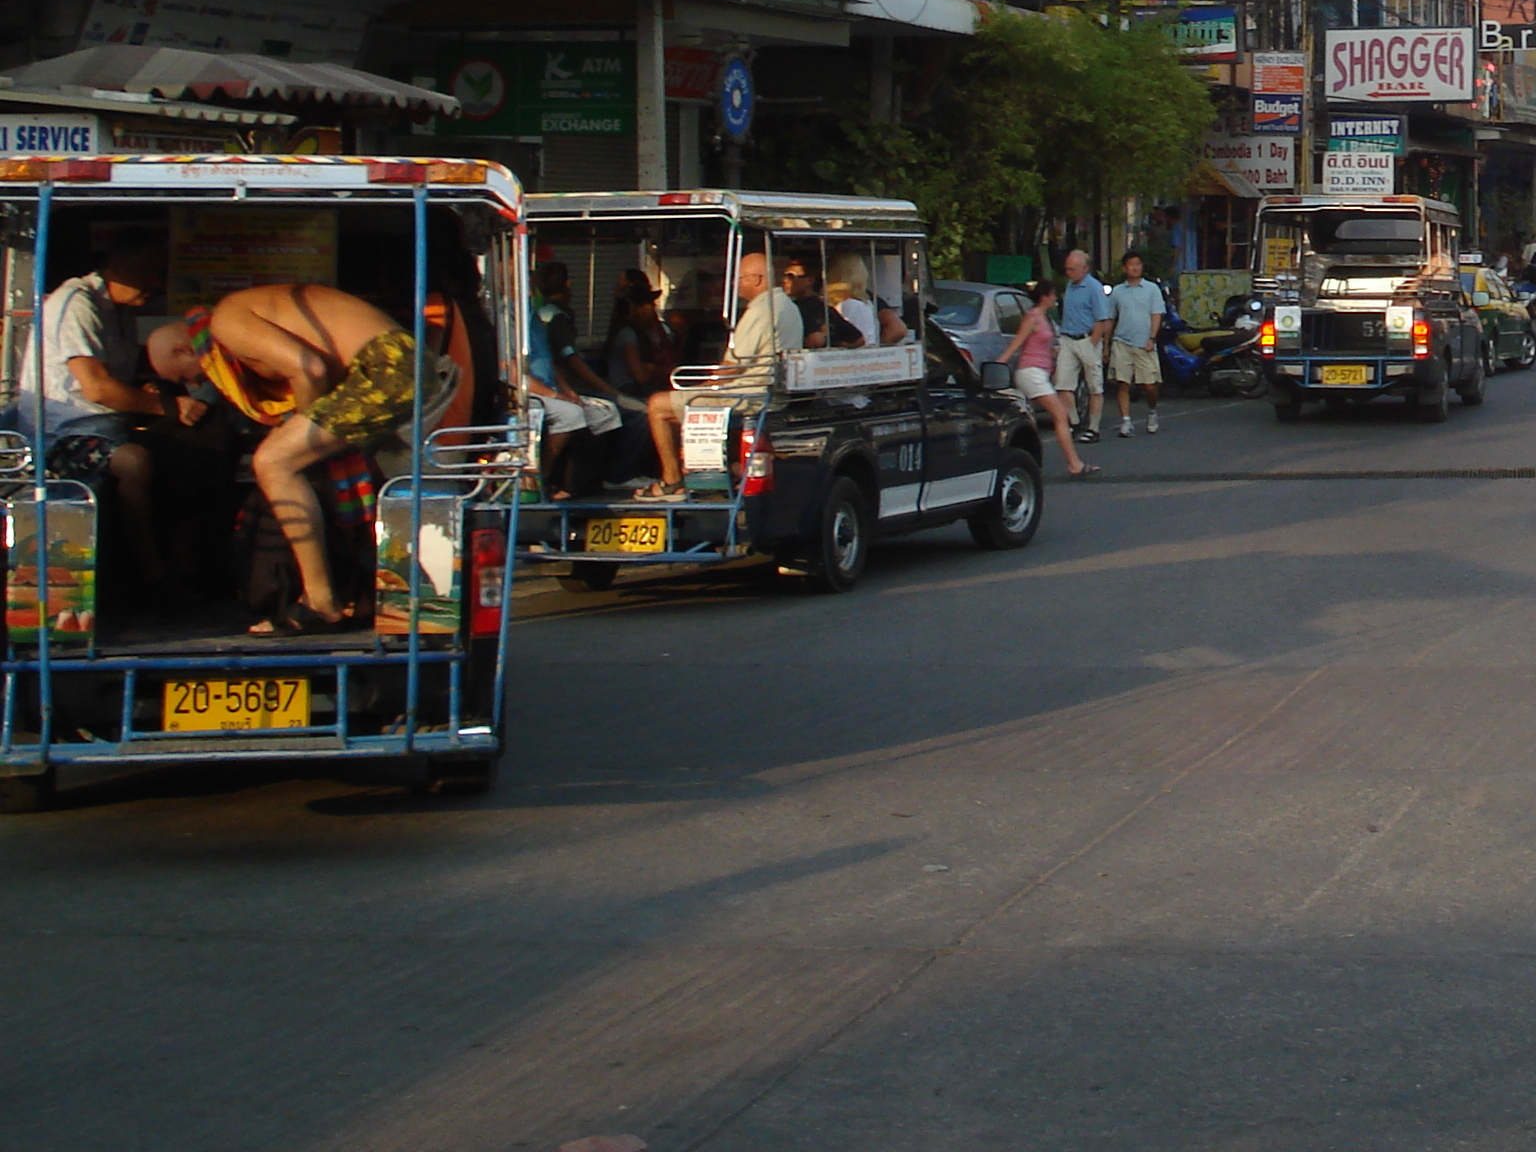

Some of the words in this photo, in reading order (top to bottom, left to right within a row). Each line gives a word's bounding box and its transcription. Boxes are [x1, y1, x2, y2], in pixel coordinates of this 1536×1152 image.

[580, 58, 622, 73] ATM
[1333, 36, 1465, 92] SHAGGER
[1377, 82, 1425, 90] BAR
[1254, 99, 1301, 117] Budget
[541, 119, 622, 131] EXCHANGE
[1330, 120, 1399, 136] INTERNET
[16, 126, 90, 151] SERVICE
[1270, 143, 1288, 161] Day
[1265, 169, 1288, 184] Baht
[1330, 177, 1360, 186] D.D.
[1362, 177, 1386, 185] INN
[591, 522, 659, 545] 20-5429
[174, 681, 299, 714] 20-5697
